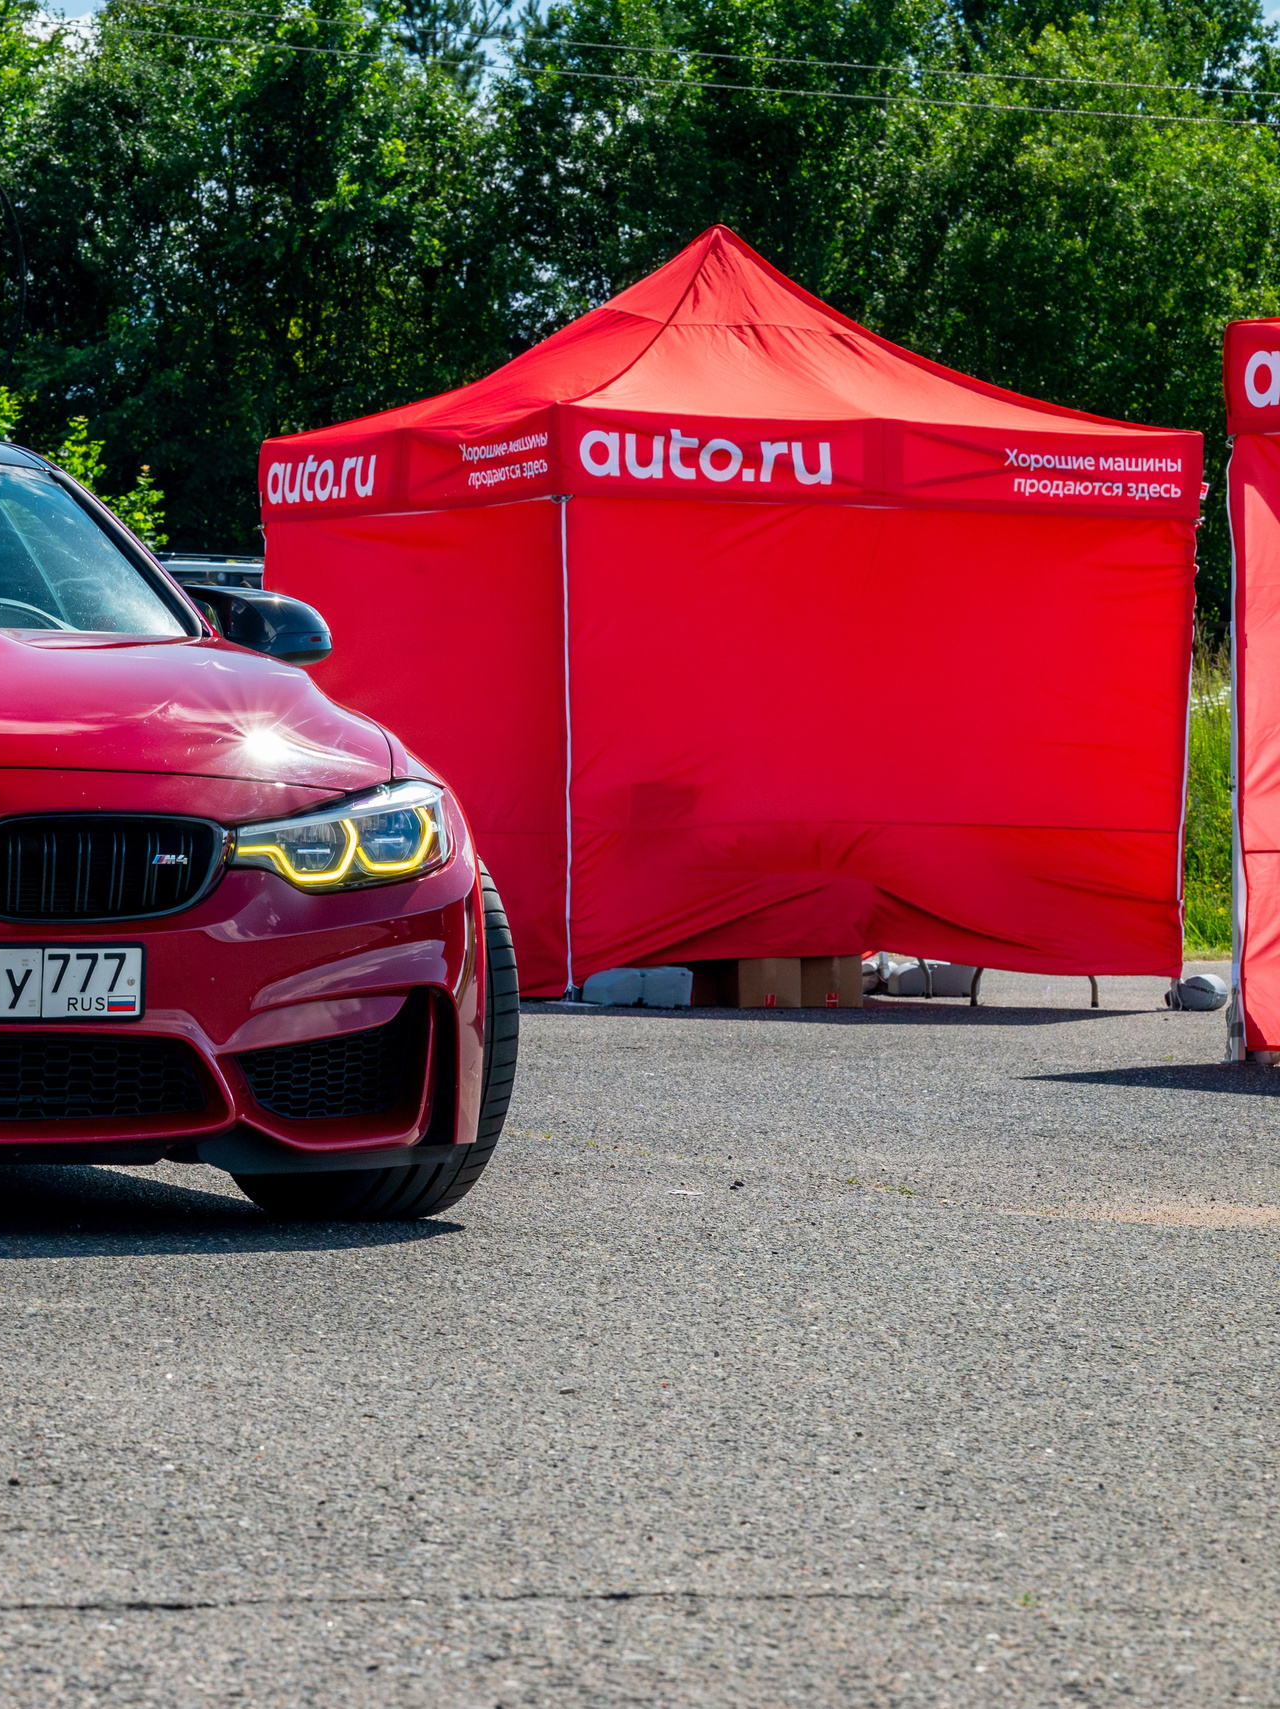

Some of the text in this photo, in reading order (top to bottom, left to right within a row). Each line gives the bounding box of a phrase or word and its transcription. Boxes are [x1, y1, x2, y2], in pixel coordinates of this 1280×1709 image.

[459, 443, 508, 465] Хорошие
[579, 428, 833, 485] auto.ru
[1004, 448, 1182, 473] Хорошие машины
[267, 454, 376, 504] auto.ru
[468, 459, 548, 489] продаются здесь
[1013, 478, 1182, 500] продаются здесь
[162, 854, 188, 865] M4
[47, 953, 127, 993] 777
[67, 997, 106, 1012] RUS
